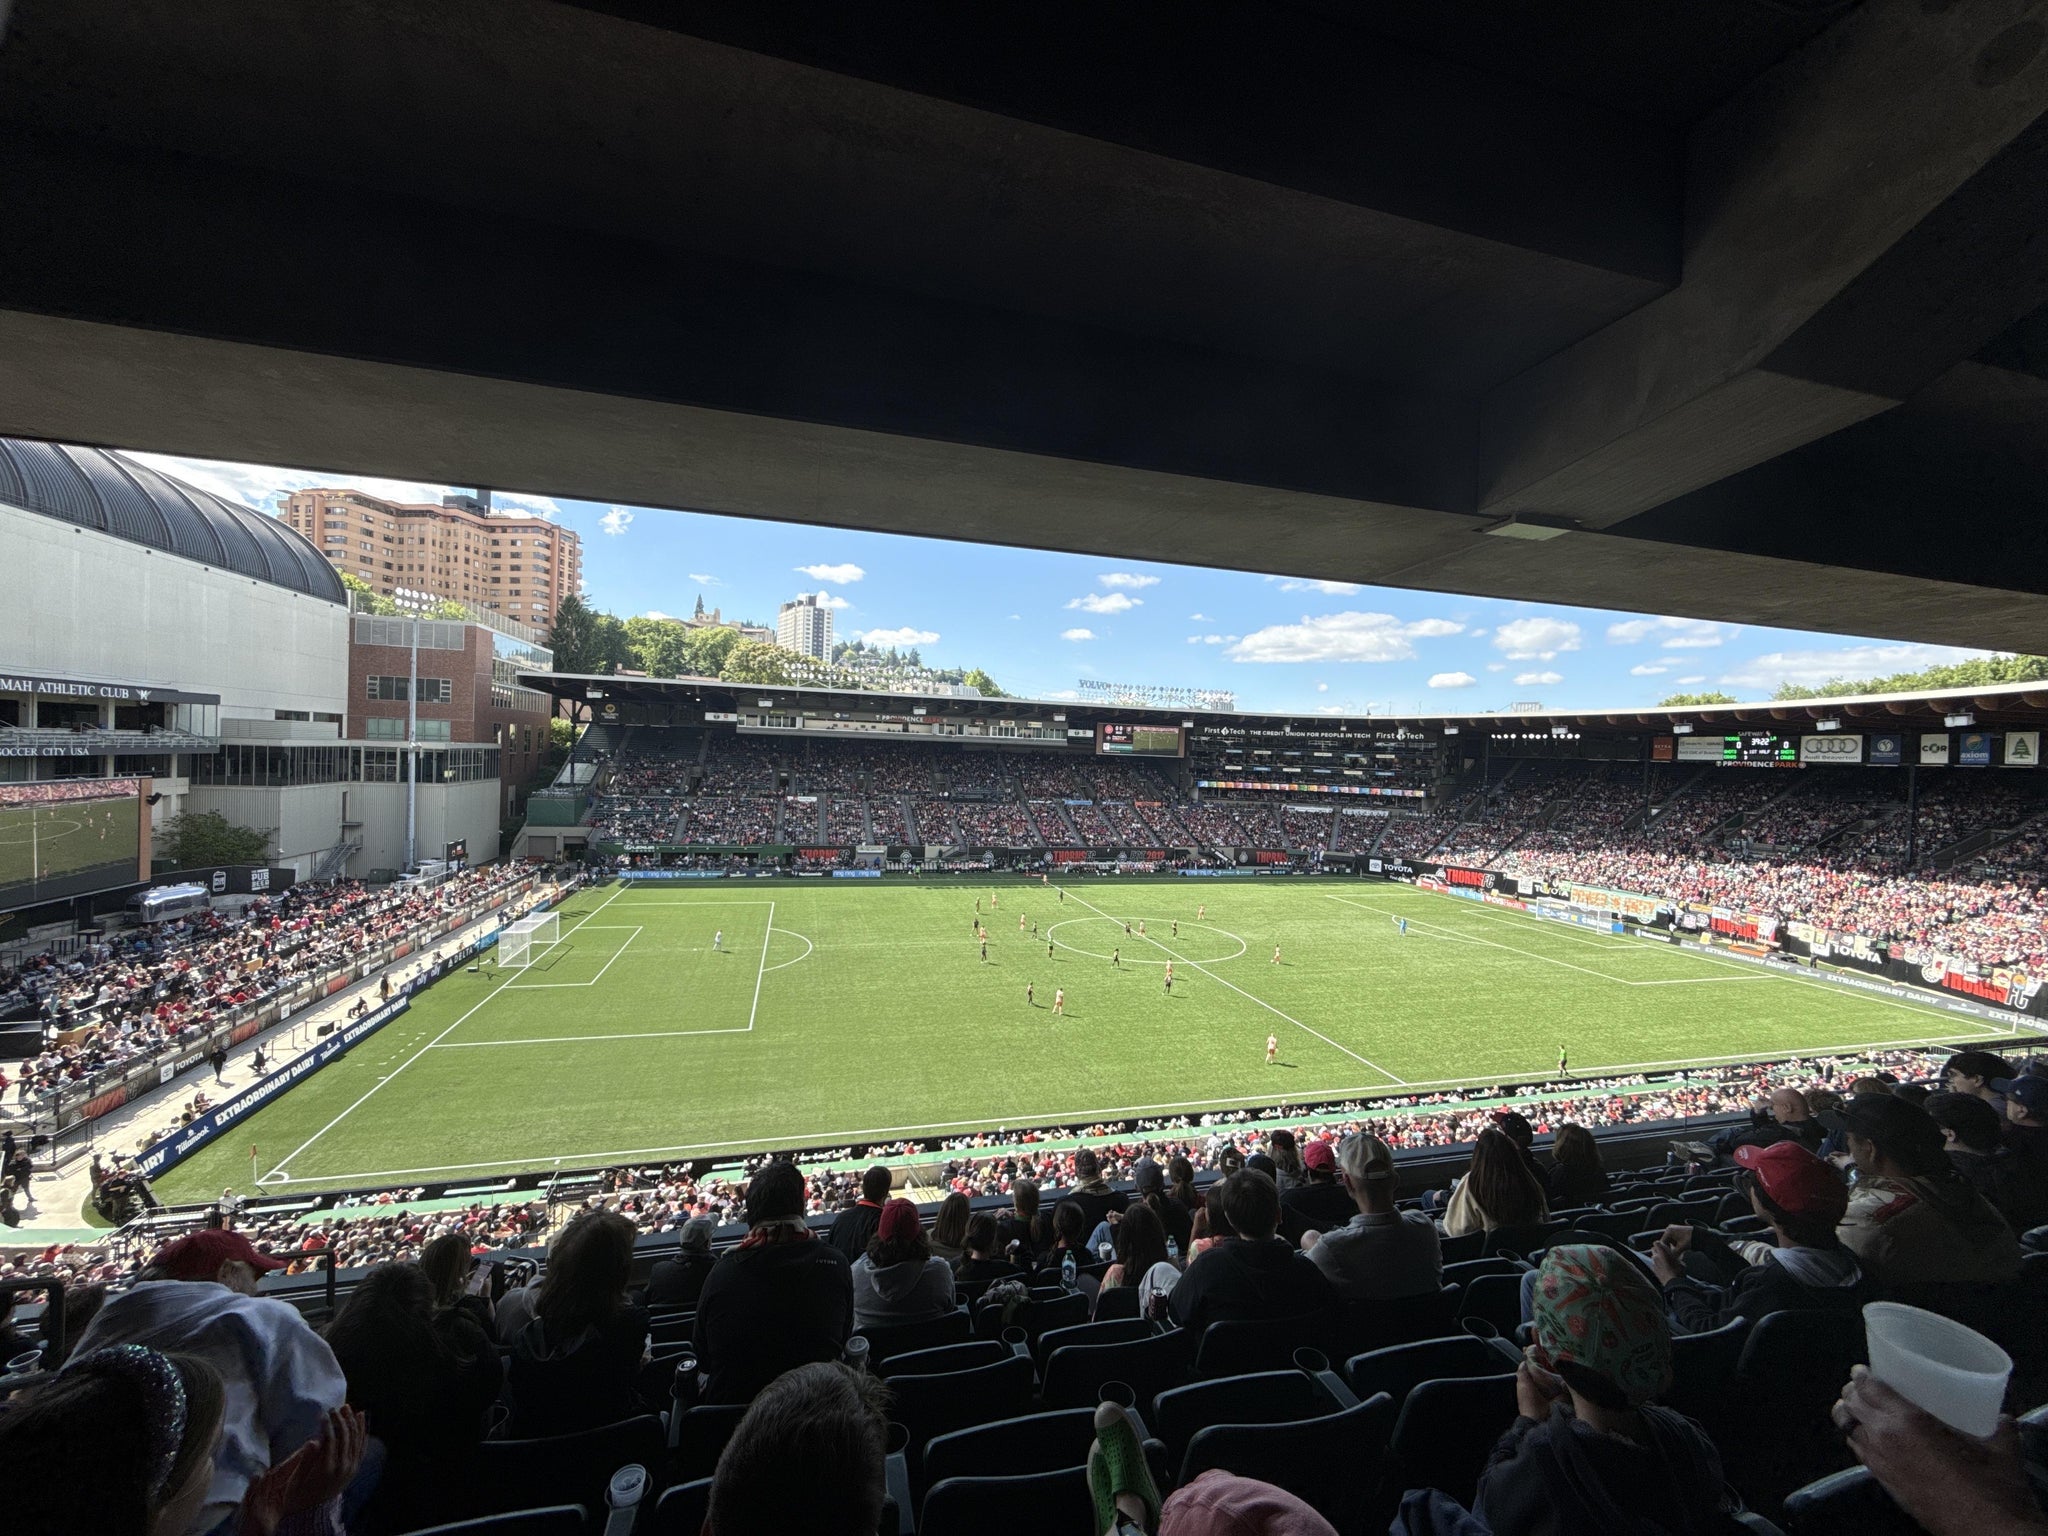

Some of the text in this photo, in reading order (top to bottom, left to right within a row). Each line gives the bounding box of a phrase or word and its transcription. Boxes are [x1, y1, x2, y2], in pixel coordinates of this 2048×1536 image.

[37, 682, 96, 696] ATHLETIC
[100, 686, 129, 698] CLUB
[1078, 679, 1108, 690] VOLVO
[42, 747, 66, 756] CITY
[70, 747, 90, 756] USA
[251, 871, 269, 881] PUB
[1383, 863, 1413, 874] TOYOTA
[1446, 868, 1484, 887] THORNS
[1482, 873, 1495, 888] FC
[453, 946, 473, 963] DELTA
[1705, 946, 1790, 971] EXTRAORDINARY DAIRY
[1826, 974, 1939, 1004] EXTRAORDINARY DAIRY
[343, 1006, 391, 1044] EXTRAORDINARY
[175, 1052, 204, 1071] TOYOTA
[214, 1053, 315, 1126] EXTRAORDINARY DAIRY
[175, 1125, 210, 1155] Tillamook
